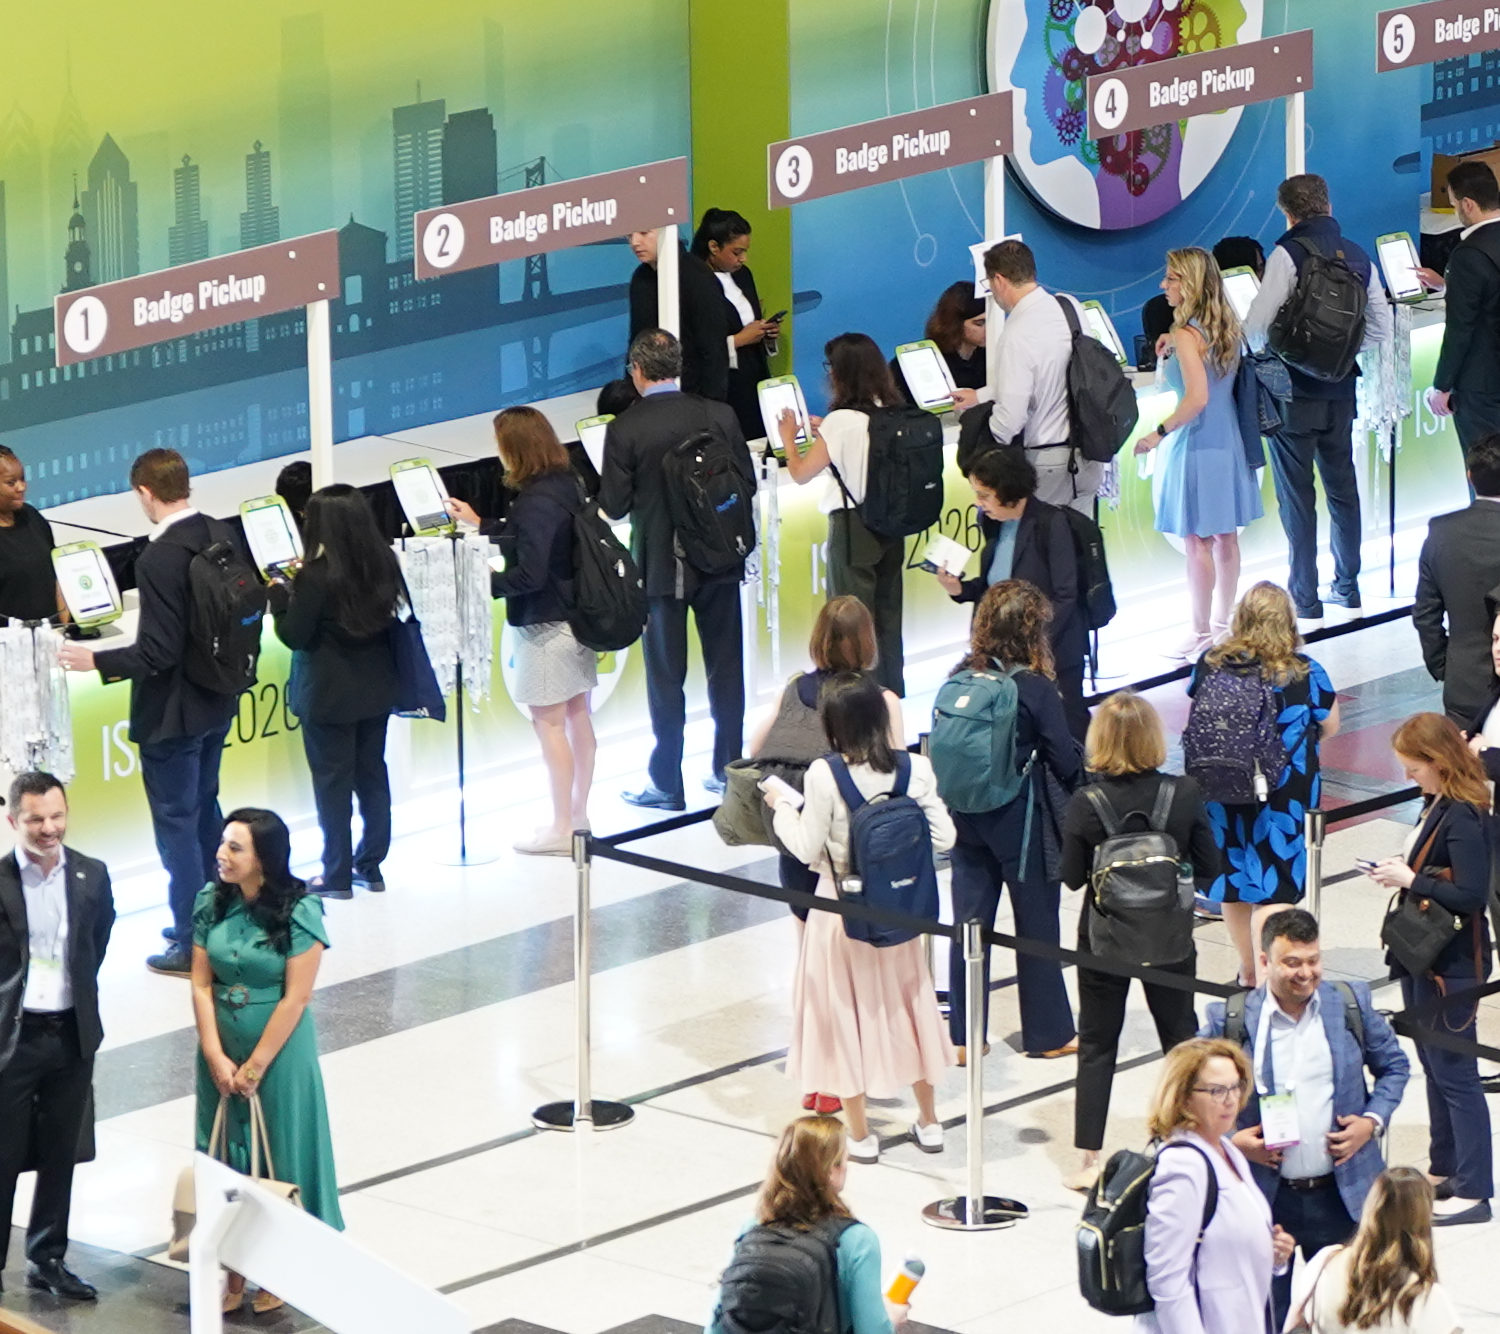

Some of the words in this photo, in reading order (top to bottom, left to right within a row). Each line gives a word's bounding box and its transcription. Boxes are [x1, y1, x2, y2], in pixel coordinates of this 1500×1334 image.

[1393, 24, 1403, 54] 5
[1435, 14, 1480, 43] Badge
[1105, 88, 1117, 118] 4
[1150, 77, 1198, 107] Badge
[1201, 65, 1255, 96] Pickup
[788, 156, 799, 187] 3
[836, 143, 888, 175] Badge
[892, 129, 950, 161] Pickup
[437, 224, 450, 257] 2
[489, 212, 547, 244] Badge
[552, 197, 617, 231] Pickup
[80, 307, 89, 341] 1
[134, 291, 194, 326] Badge
[199, 274, 265, 310] Pickup
